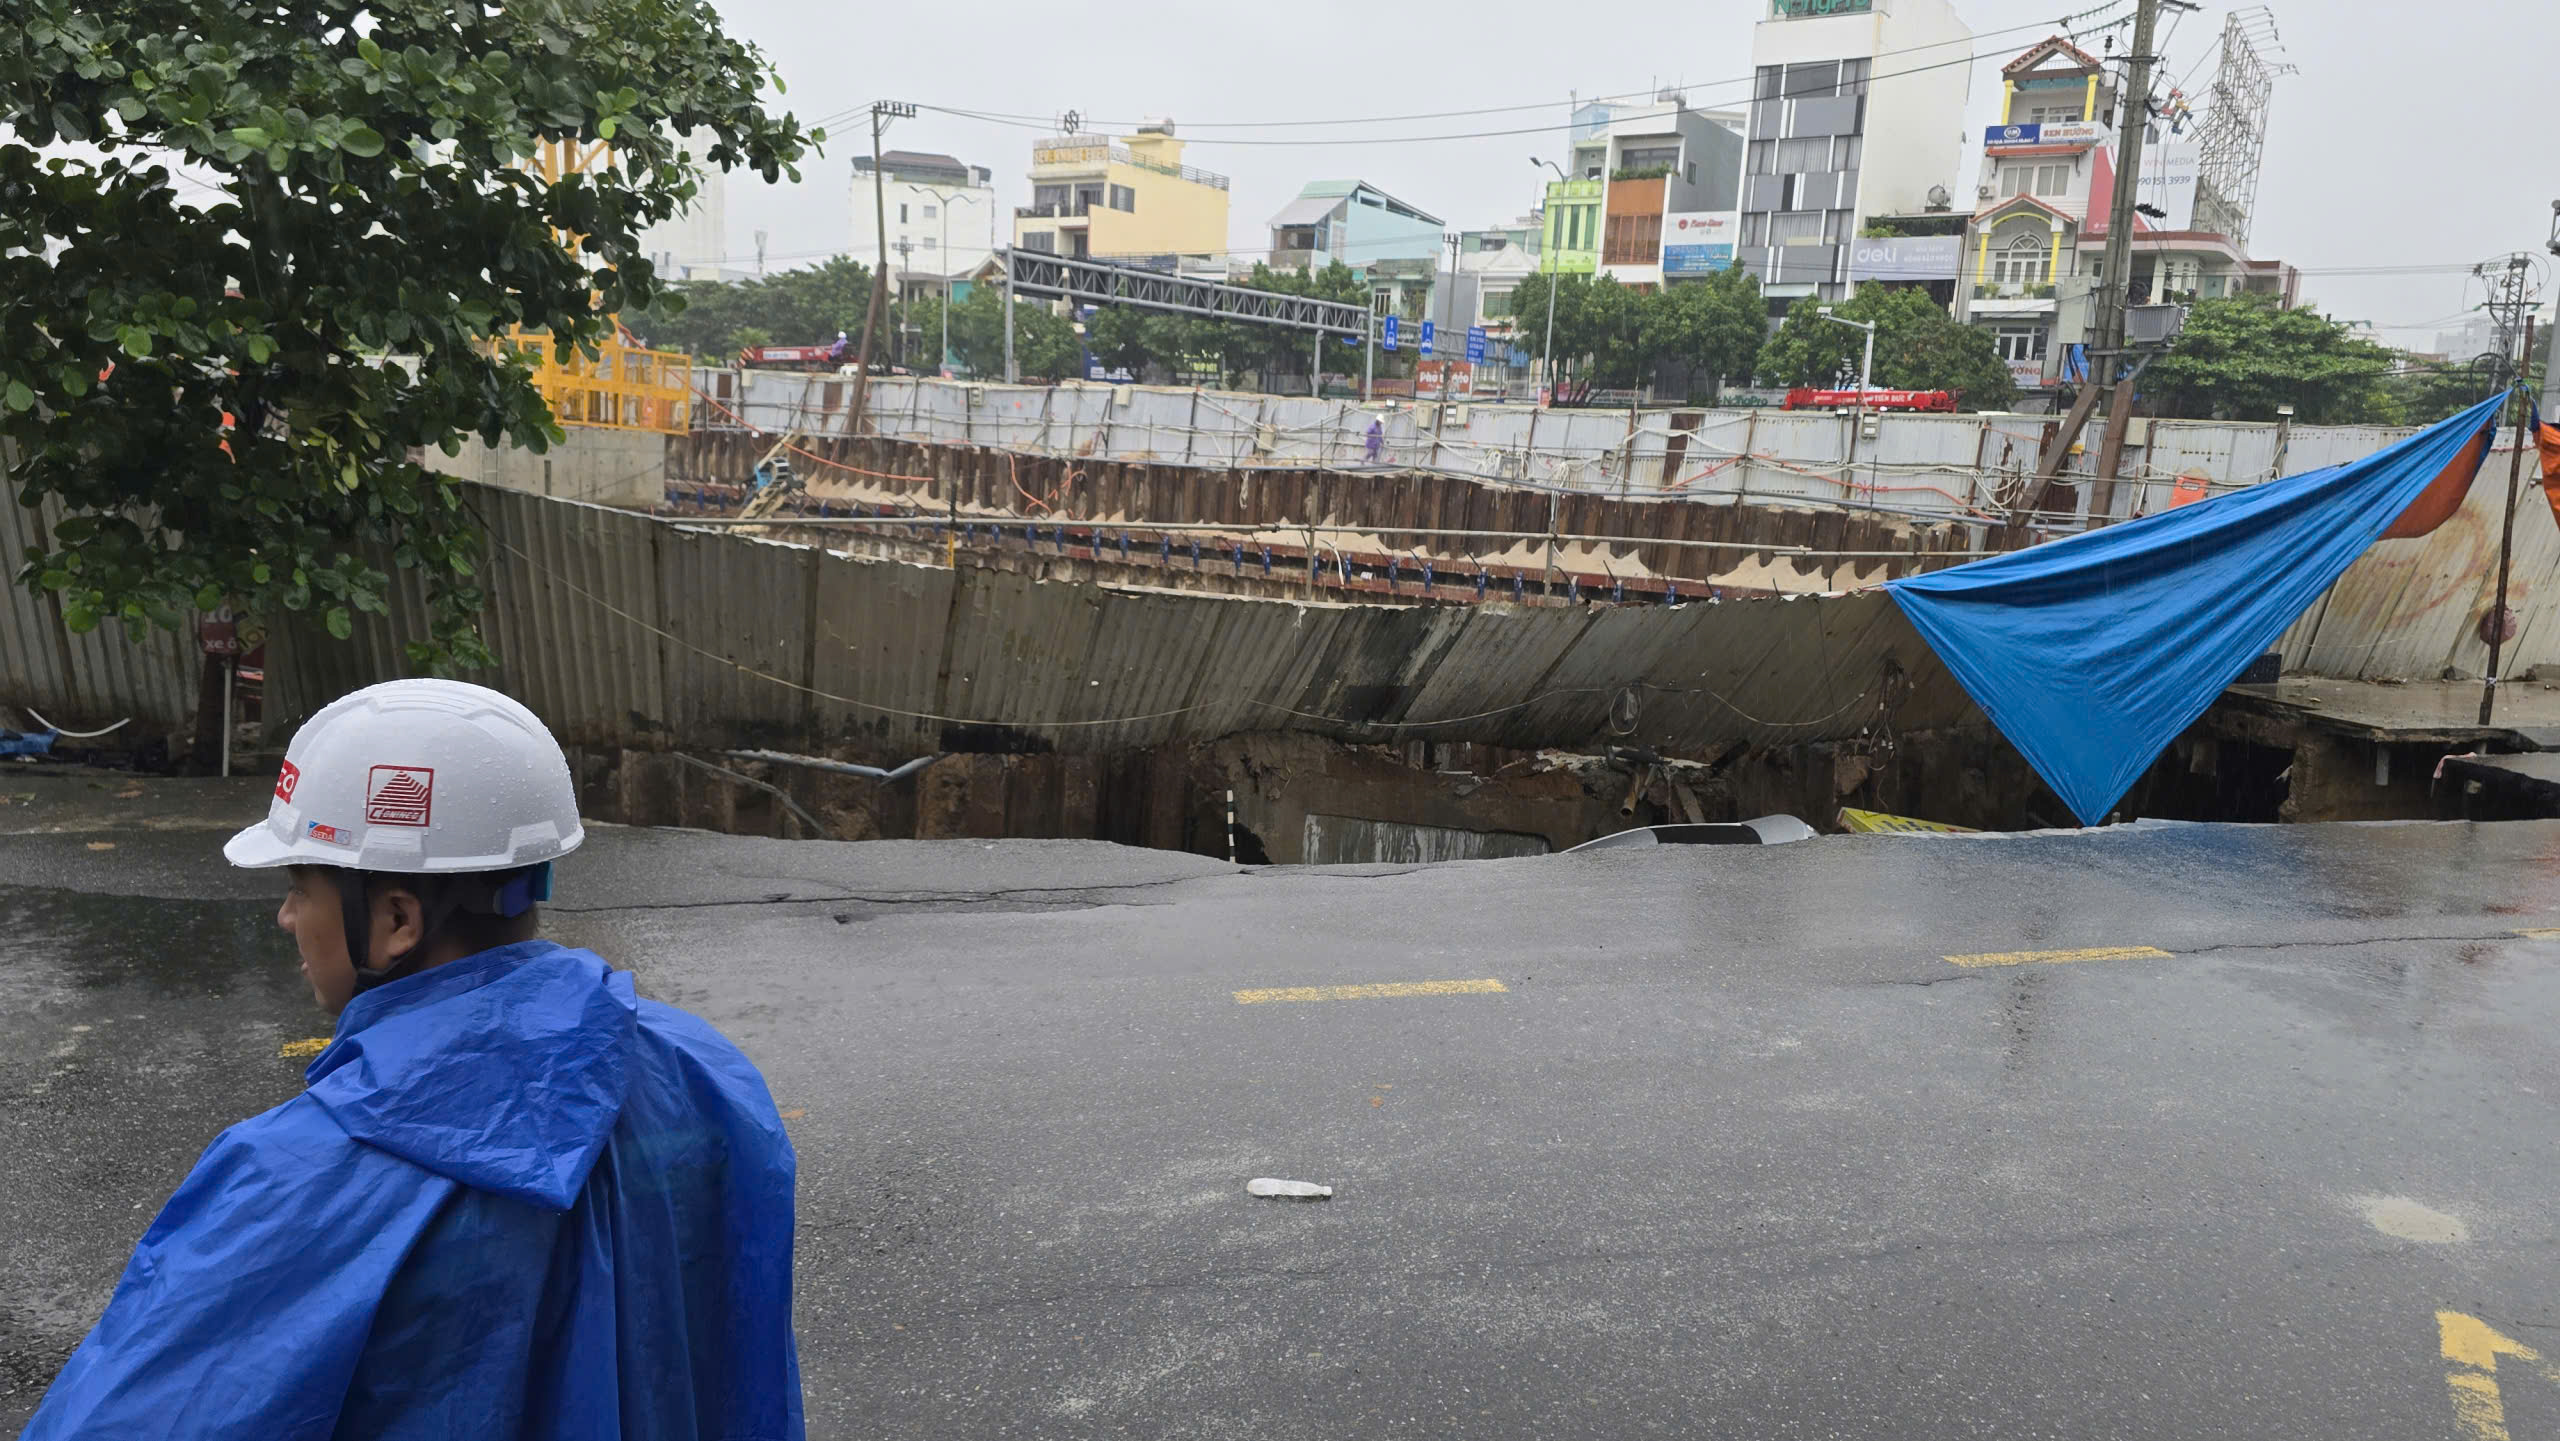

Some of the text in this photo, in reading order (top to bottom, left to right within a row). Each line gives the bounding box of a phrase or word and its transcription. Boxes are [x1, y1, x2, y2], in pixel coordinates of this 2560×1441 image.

[2167, 157, 2195, 166] MEDIA
[2168, 175, 2191, 185] 3939
[1857, 248, 1896, 263] deli
[205, 640, 224, 649] xe
[312, 830, 333, 841] SEDA
